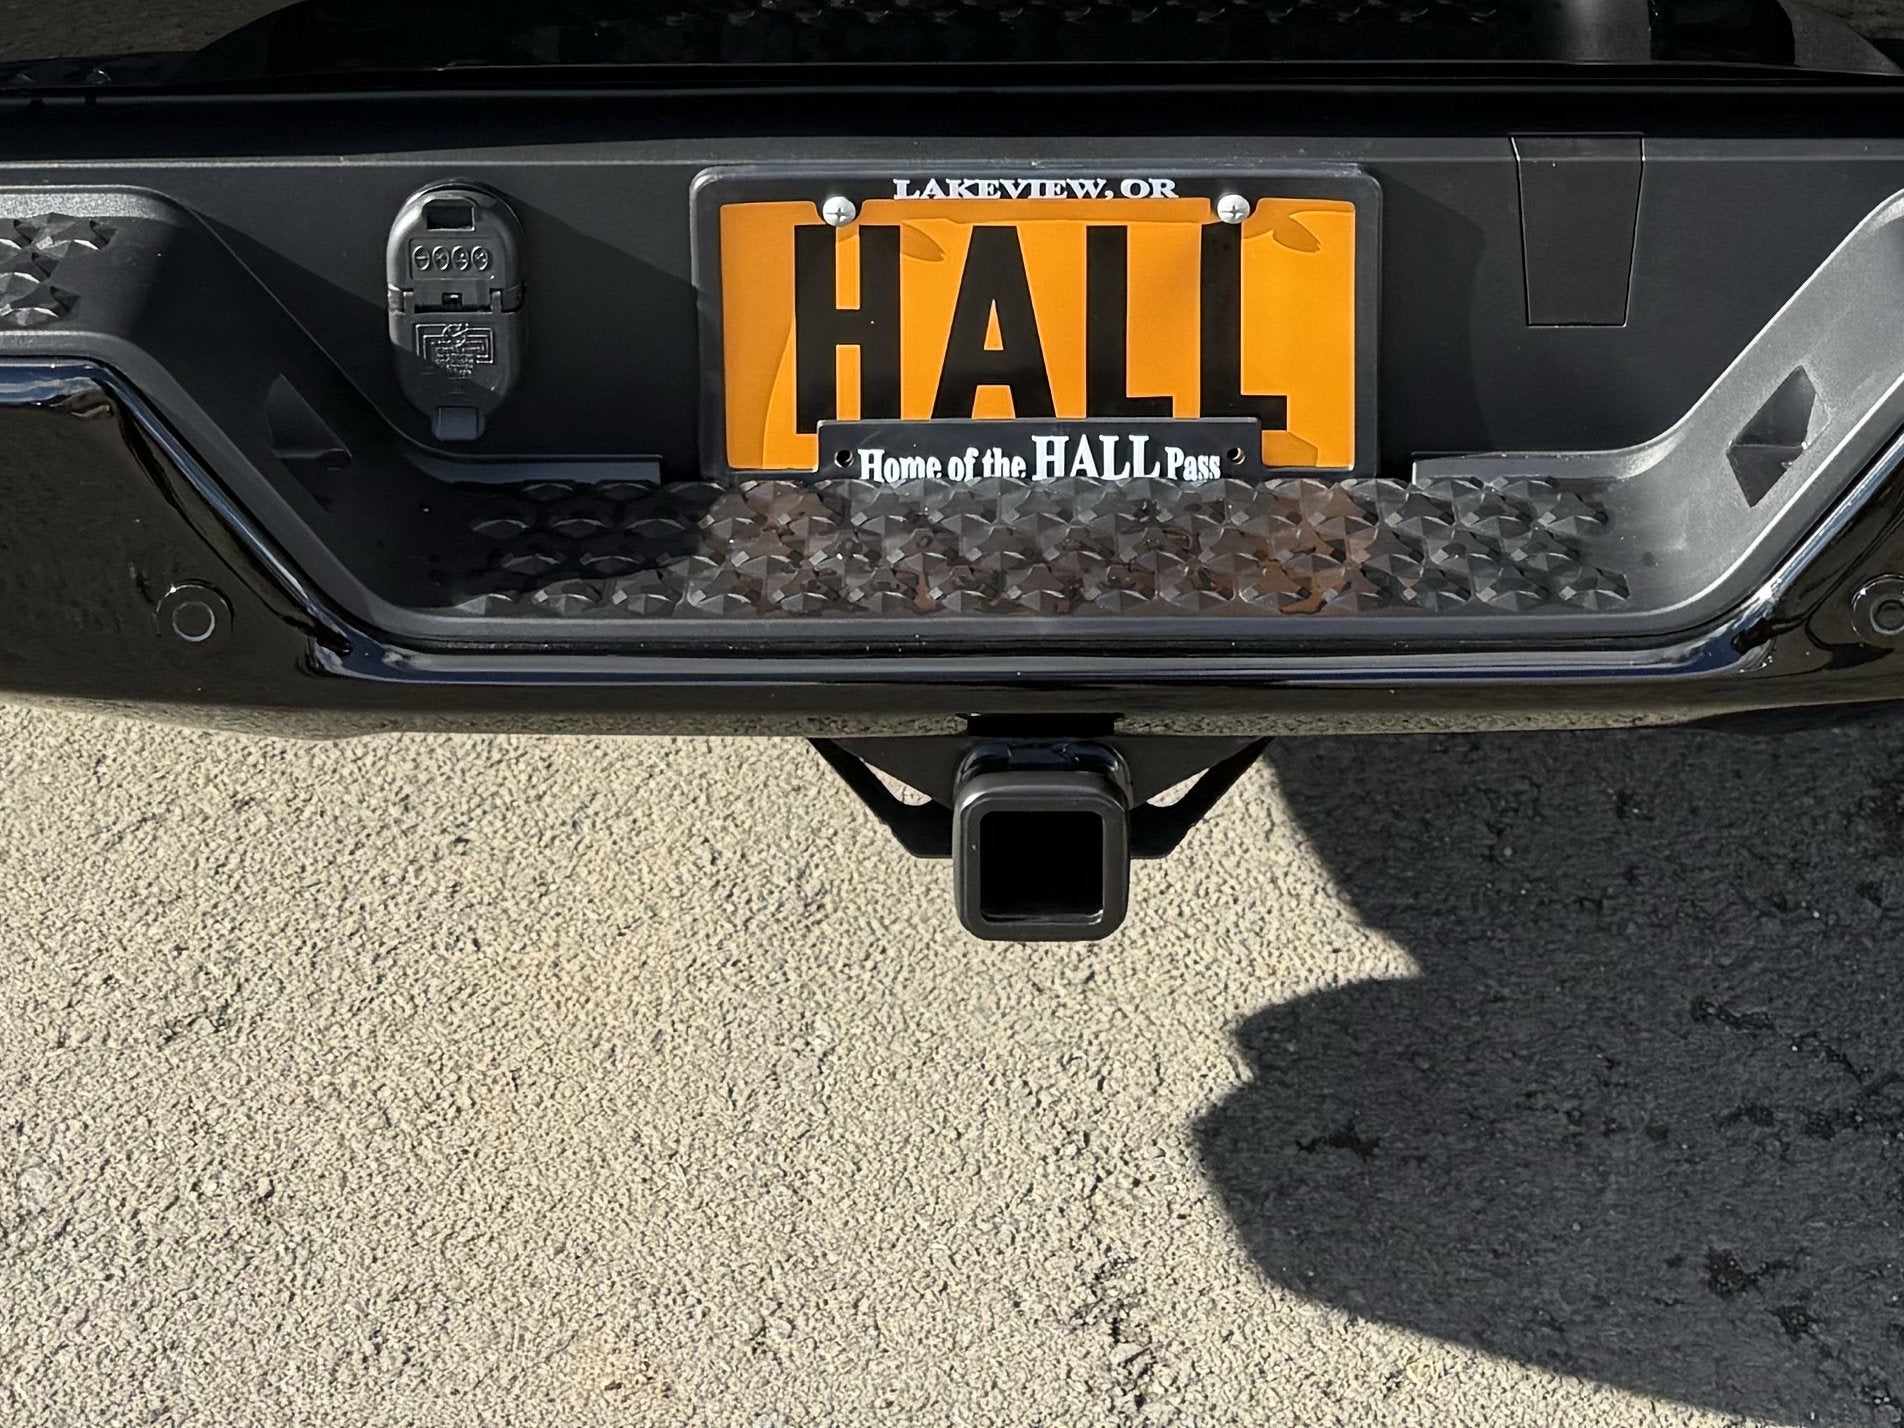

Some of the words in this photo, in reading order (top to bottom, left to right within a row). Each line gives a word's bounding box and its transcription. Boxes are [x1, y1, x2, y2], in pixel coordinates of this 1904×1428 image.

[892, 178, 1114, 201] LAKEVIEW,
[1119, 178, 1180, 199] OR
[794, 224, 1288, 435] HALL
[856, 448, 942, 482] Home
[947, 447, 979, 482] of
[981, 447, 1027, 480] the
[1031, 433, 1161, 481] HALL
[1164, 446, 1221, 482] Pass
